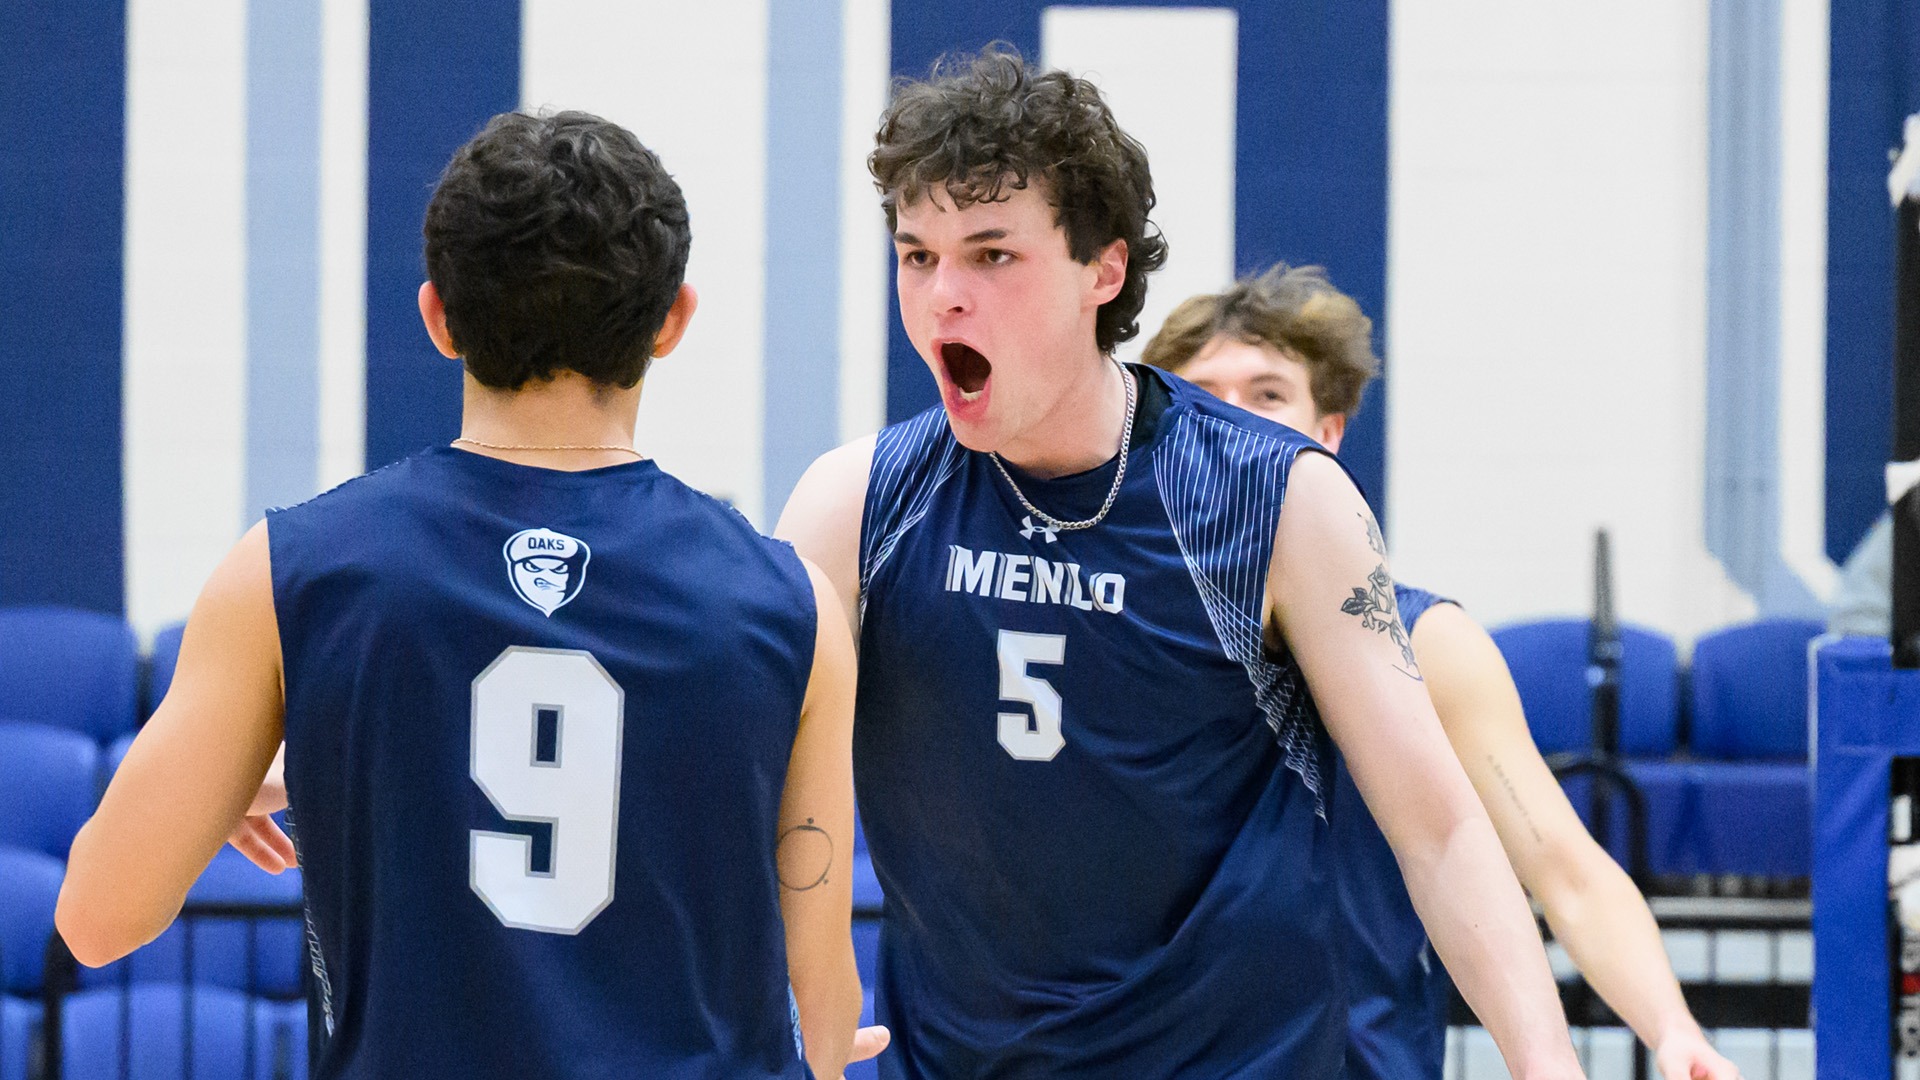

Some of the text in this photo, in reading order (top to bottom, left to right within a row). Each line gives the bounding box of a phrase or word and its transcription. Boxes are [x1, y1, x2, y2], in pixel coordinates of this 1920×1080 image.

[527, 537, 565, 551] OAKS
[945, 545, 1126, 614] MENLO
[997, 629, 1066, 762] 5
[469, 645, 625, 935] 9
